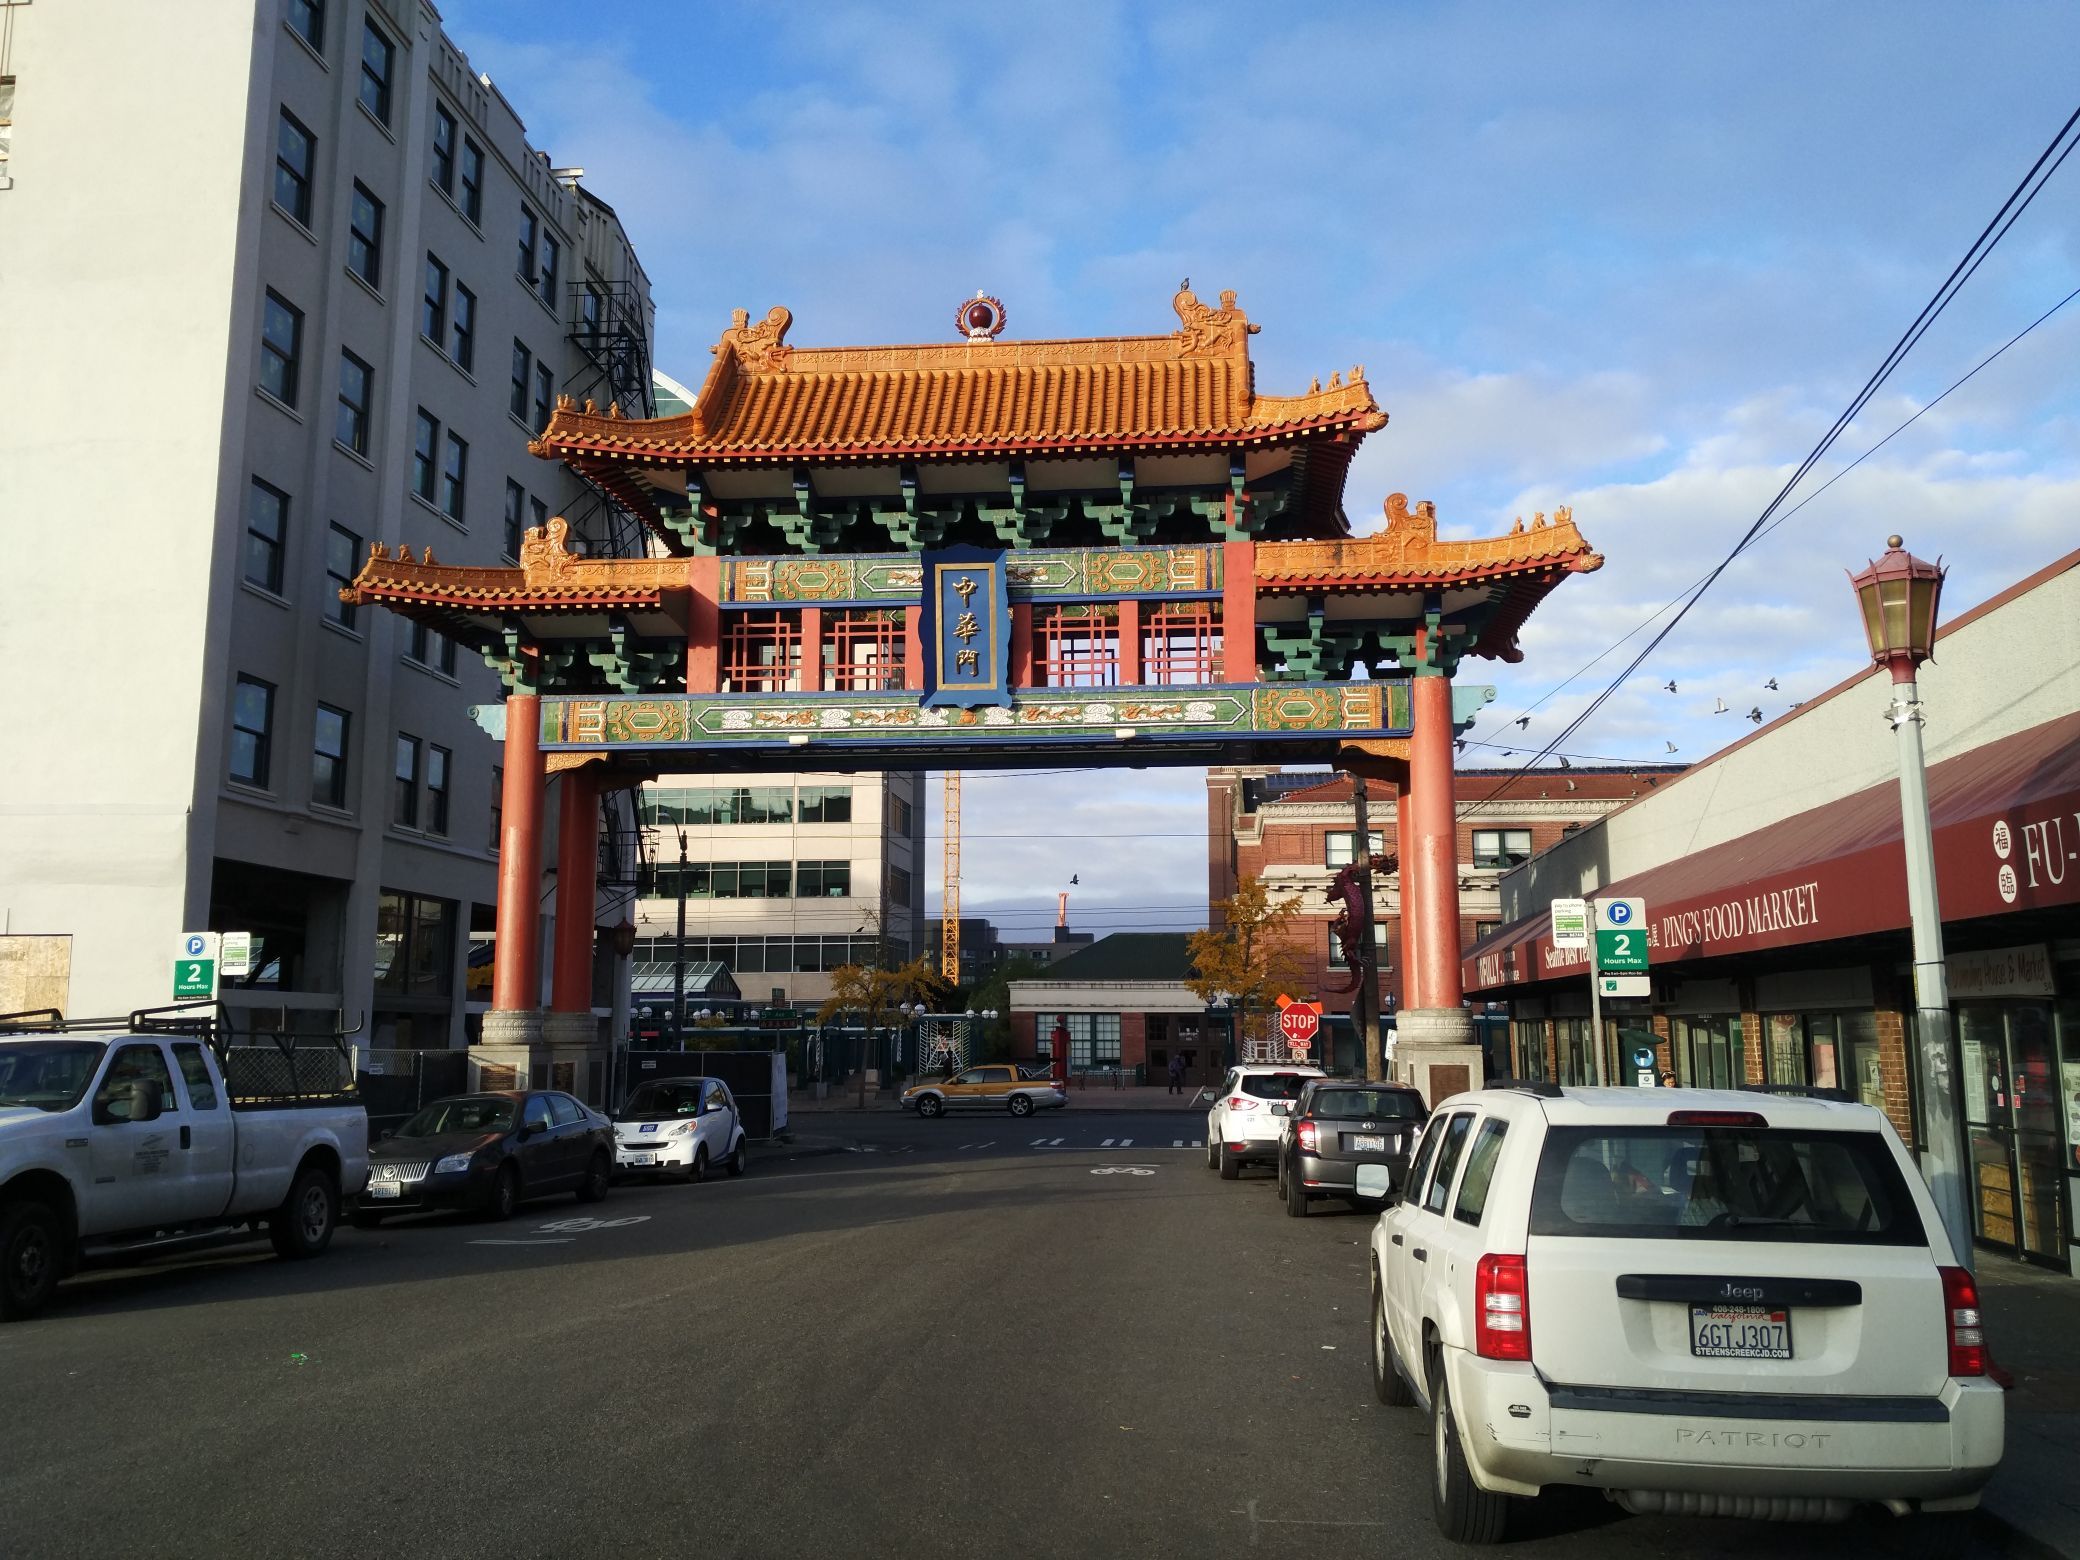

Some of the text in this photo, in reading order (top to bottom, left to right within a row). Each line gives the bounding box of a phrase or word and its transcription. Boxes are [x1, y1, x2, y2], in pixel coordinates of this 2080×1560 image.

[952, 577, 981, 677] 中華門
[2021, 812, 2080, 888] FU-
[1663, 911, 1701, 948] PING'S
[1703, 901, 1744, 942] FOOD
[1746, 881, 1819, 935] MARKET
[1614, 934, 1631, 956] 2
[1545, 946, 1565, 969] Seattle
[2017, 951, 2046, 983] Market
[187, 963, 201, 982] 2
[1283, 1014, 1315, 1029] STOP
[1720, 1283, 1764, 1301] Jeep
[1698, 1324, 1783, 1349] 6GTJ307
[1695, 1347, 1790, 1358] STEVENSCREEKCJD.COM
[1676, 1428, 1832, 1449] PATRIOT
